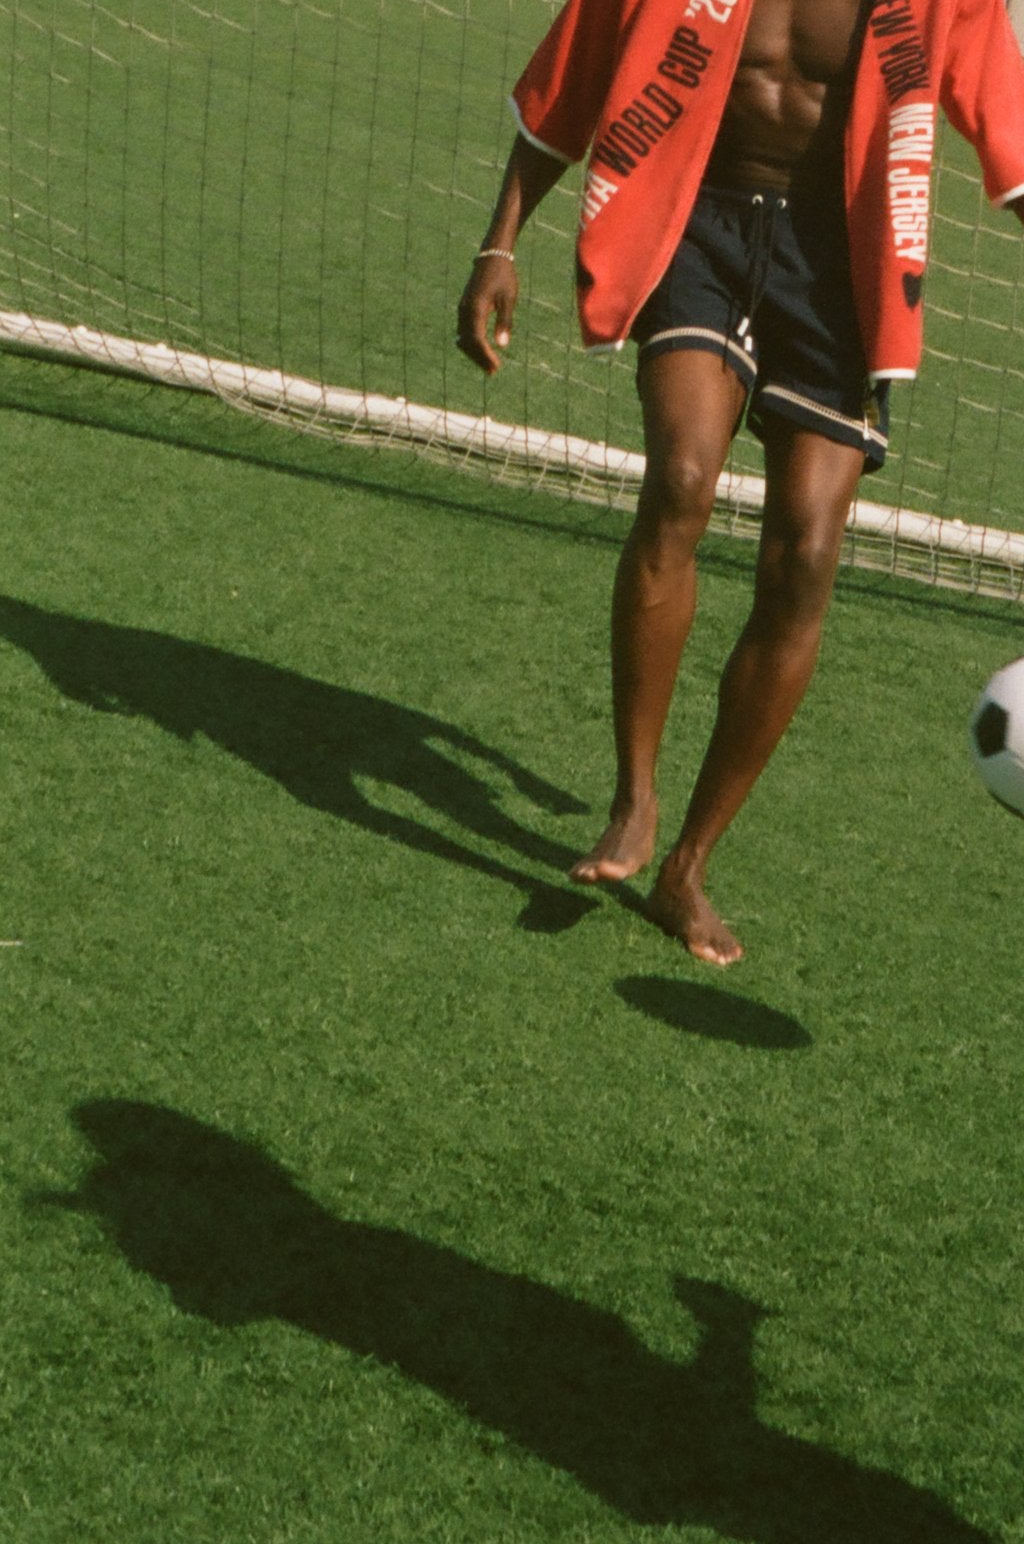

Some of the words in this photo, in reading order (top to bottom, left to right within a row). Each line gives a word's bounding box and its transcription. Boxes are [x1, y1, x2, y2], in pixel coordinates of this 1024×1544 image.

[595, 82, 684, 178] WORLD
[657, 24, 713, 89] CUP
[878, 34, 930, 106] YORK
[889, 103, 934, 162] NEW
[888, 166, 930, 263] JERSEY
